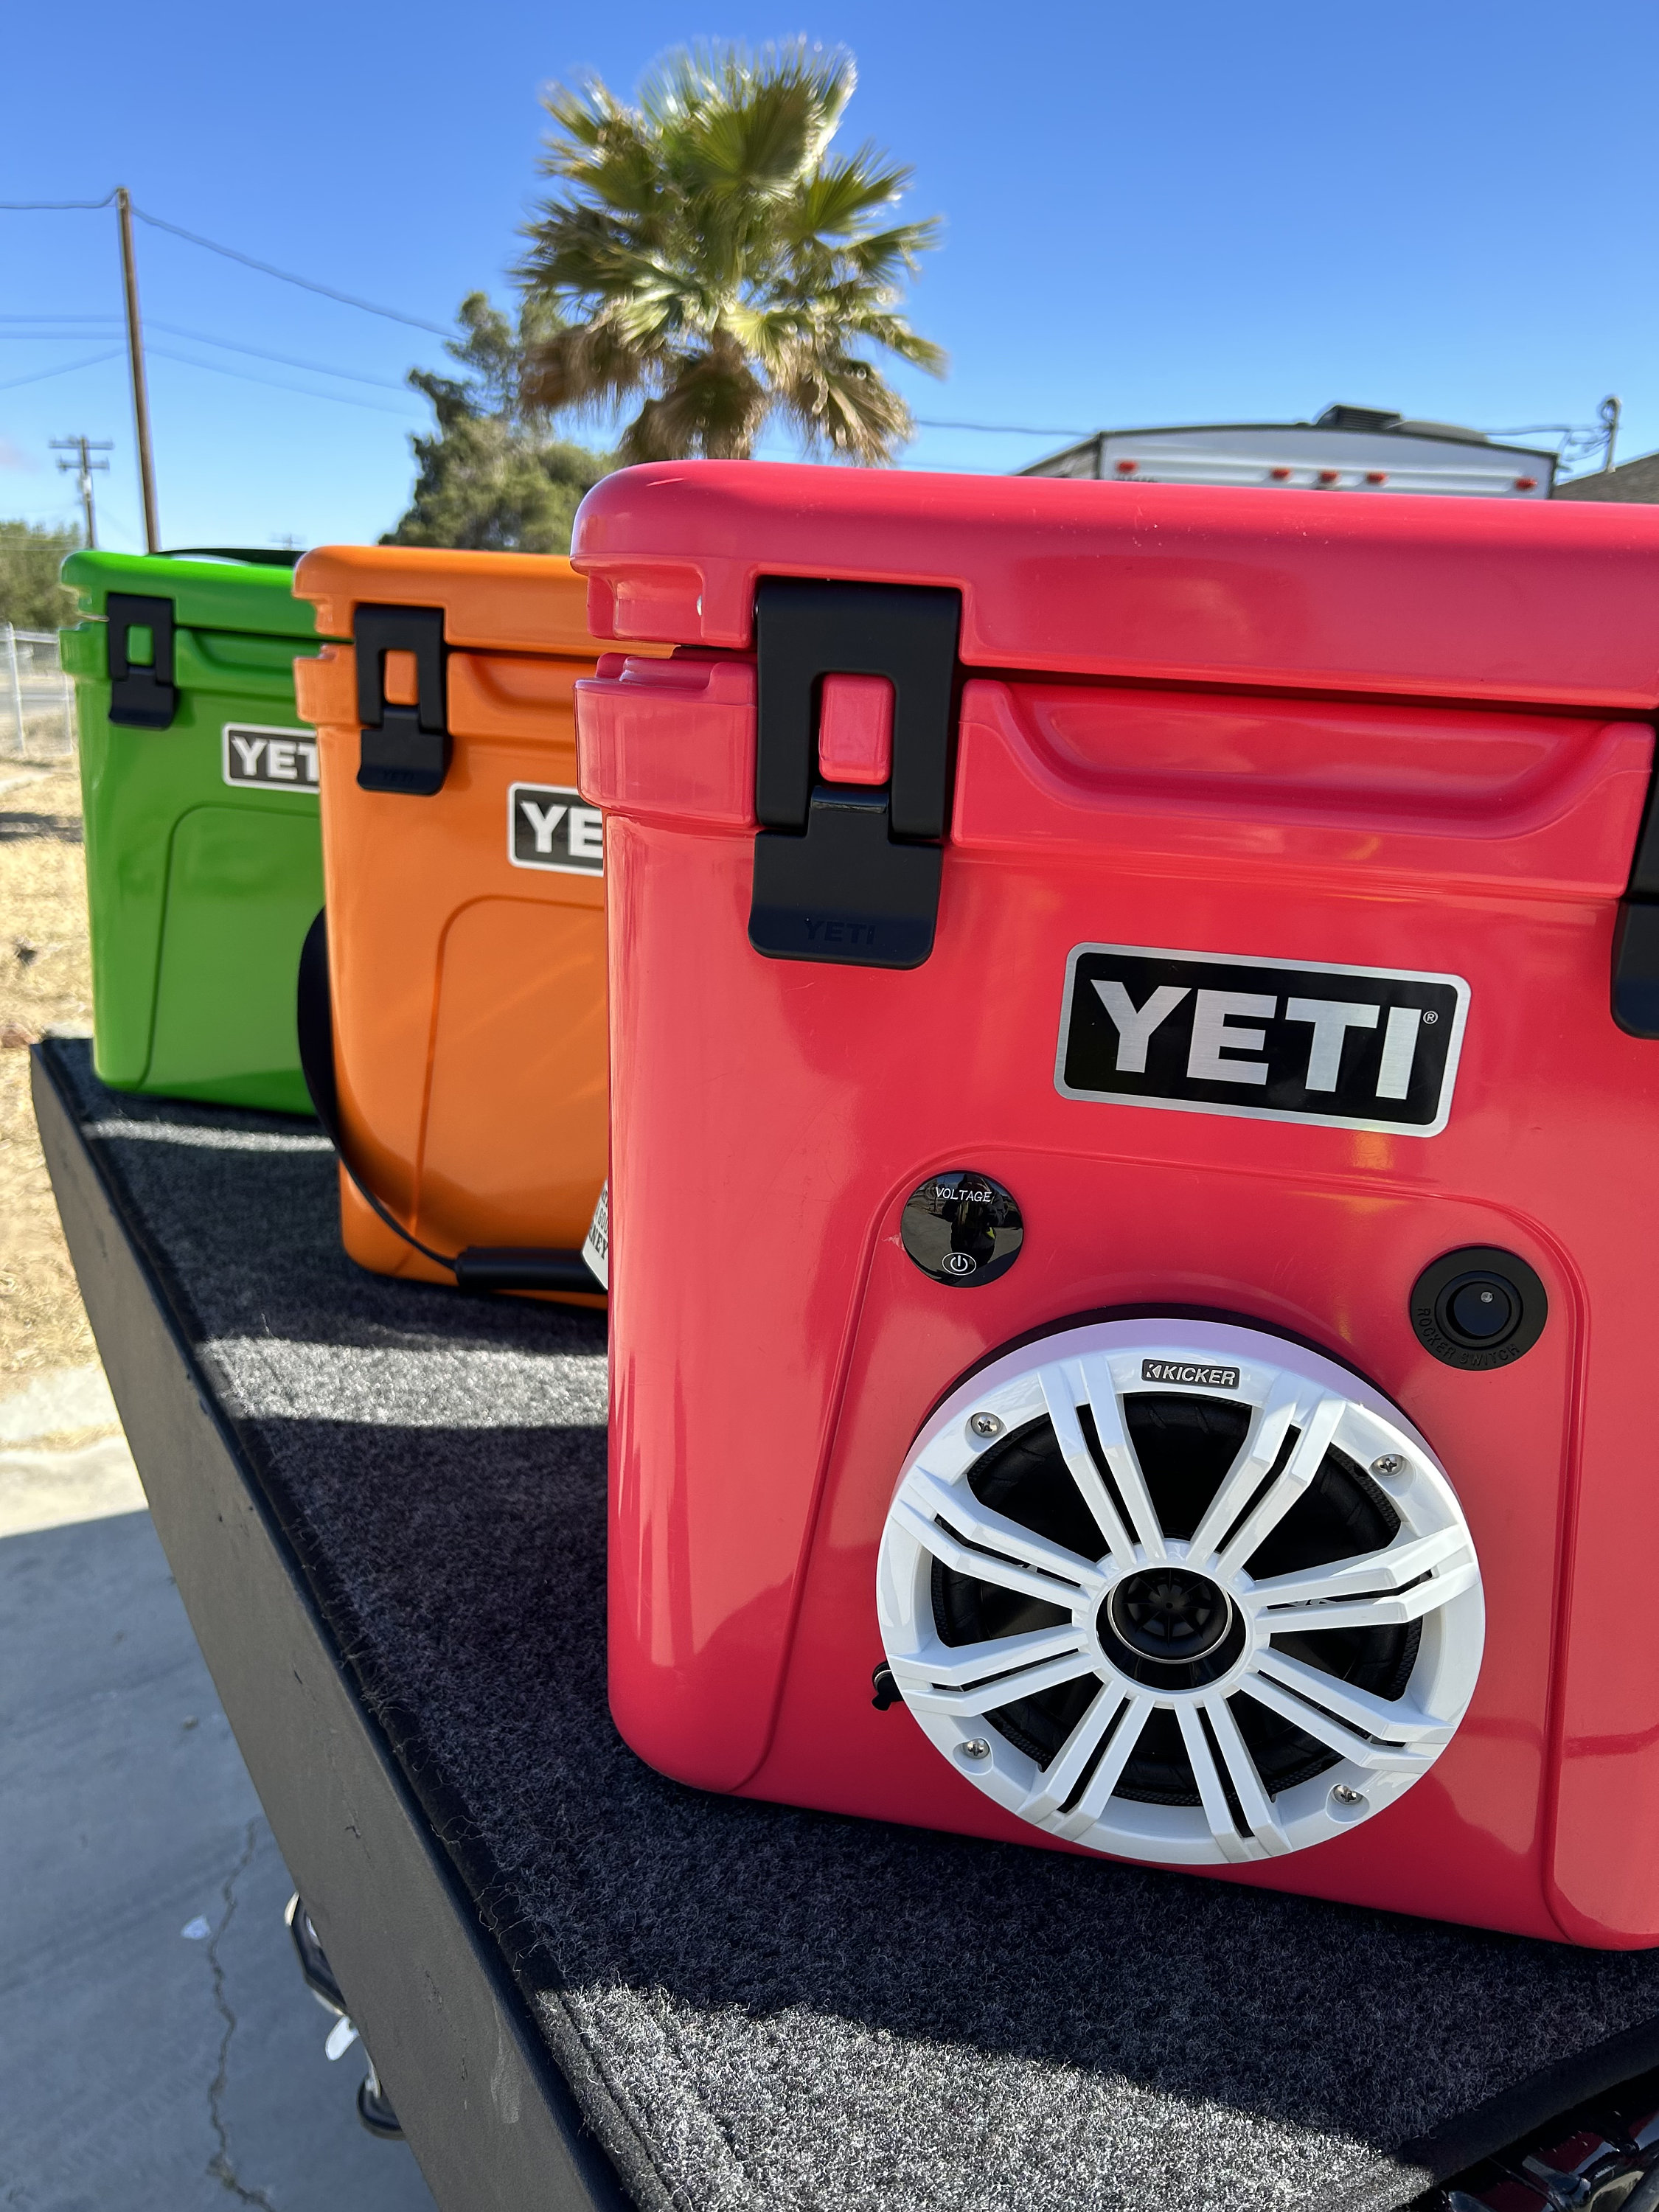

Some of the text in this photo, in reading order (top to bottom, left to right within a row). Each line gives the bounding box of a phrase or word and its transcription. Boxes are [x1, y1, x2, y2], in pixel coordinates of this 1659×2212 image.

[231, 736, 319, 782] YET
[519, 800, 603, 858] YE
[804, 920, 876, 945] YETI
[936, 1186, 992, 1203] VOLTAGE
[1417, 1308, 1520, 1366] ROCKER SWITCH
[1162, 1365, 1236, 1385] KICKER
